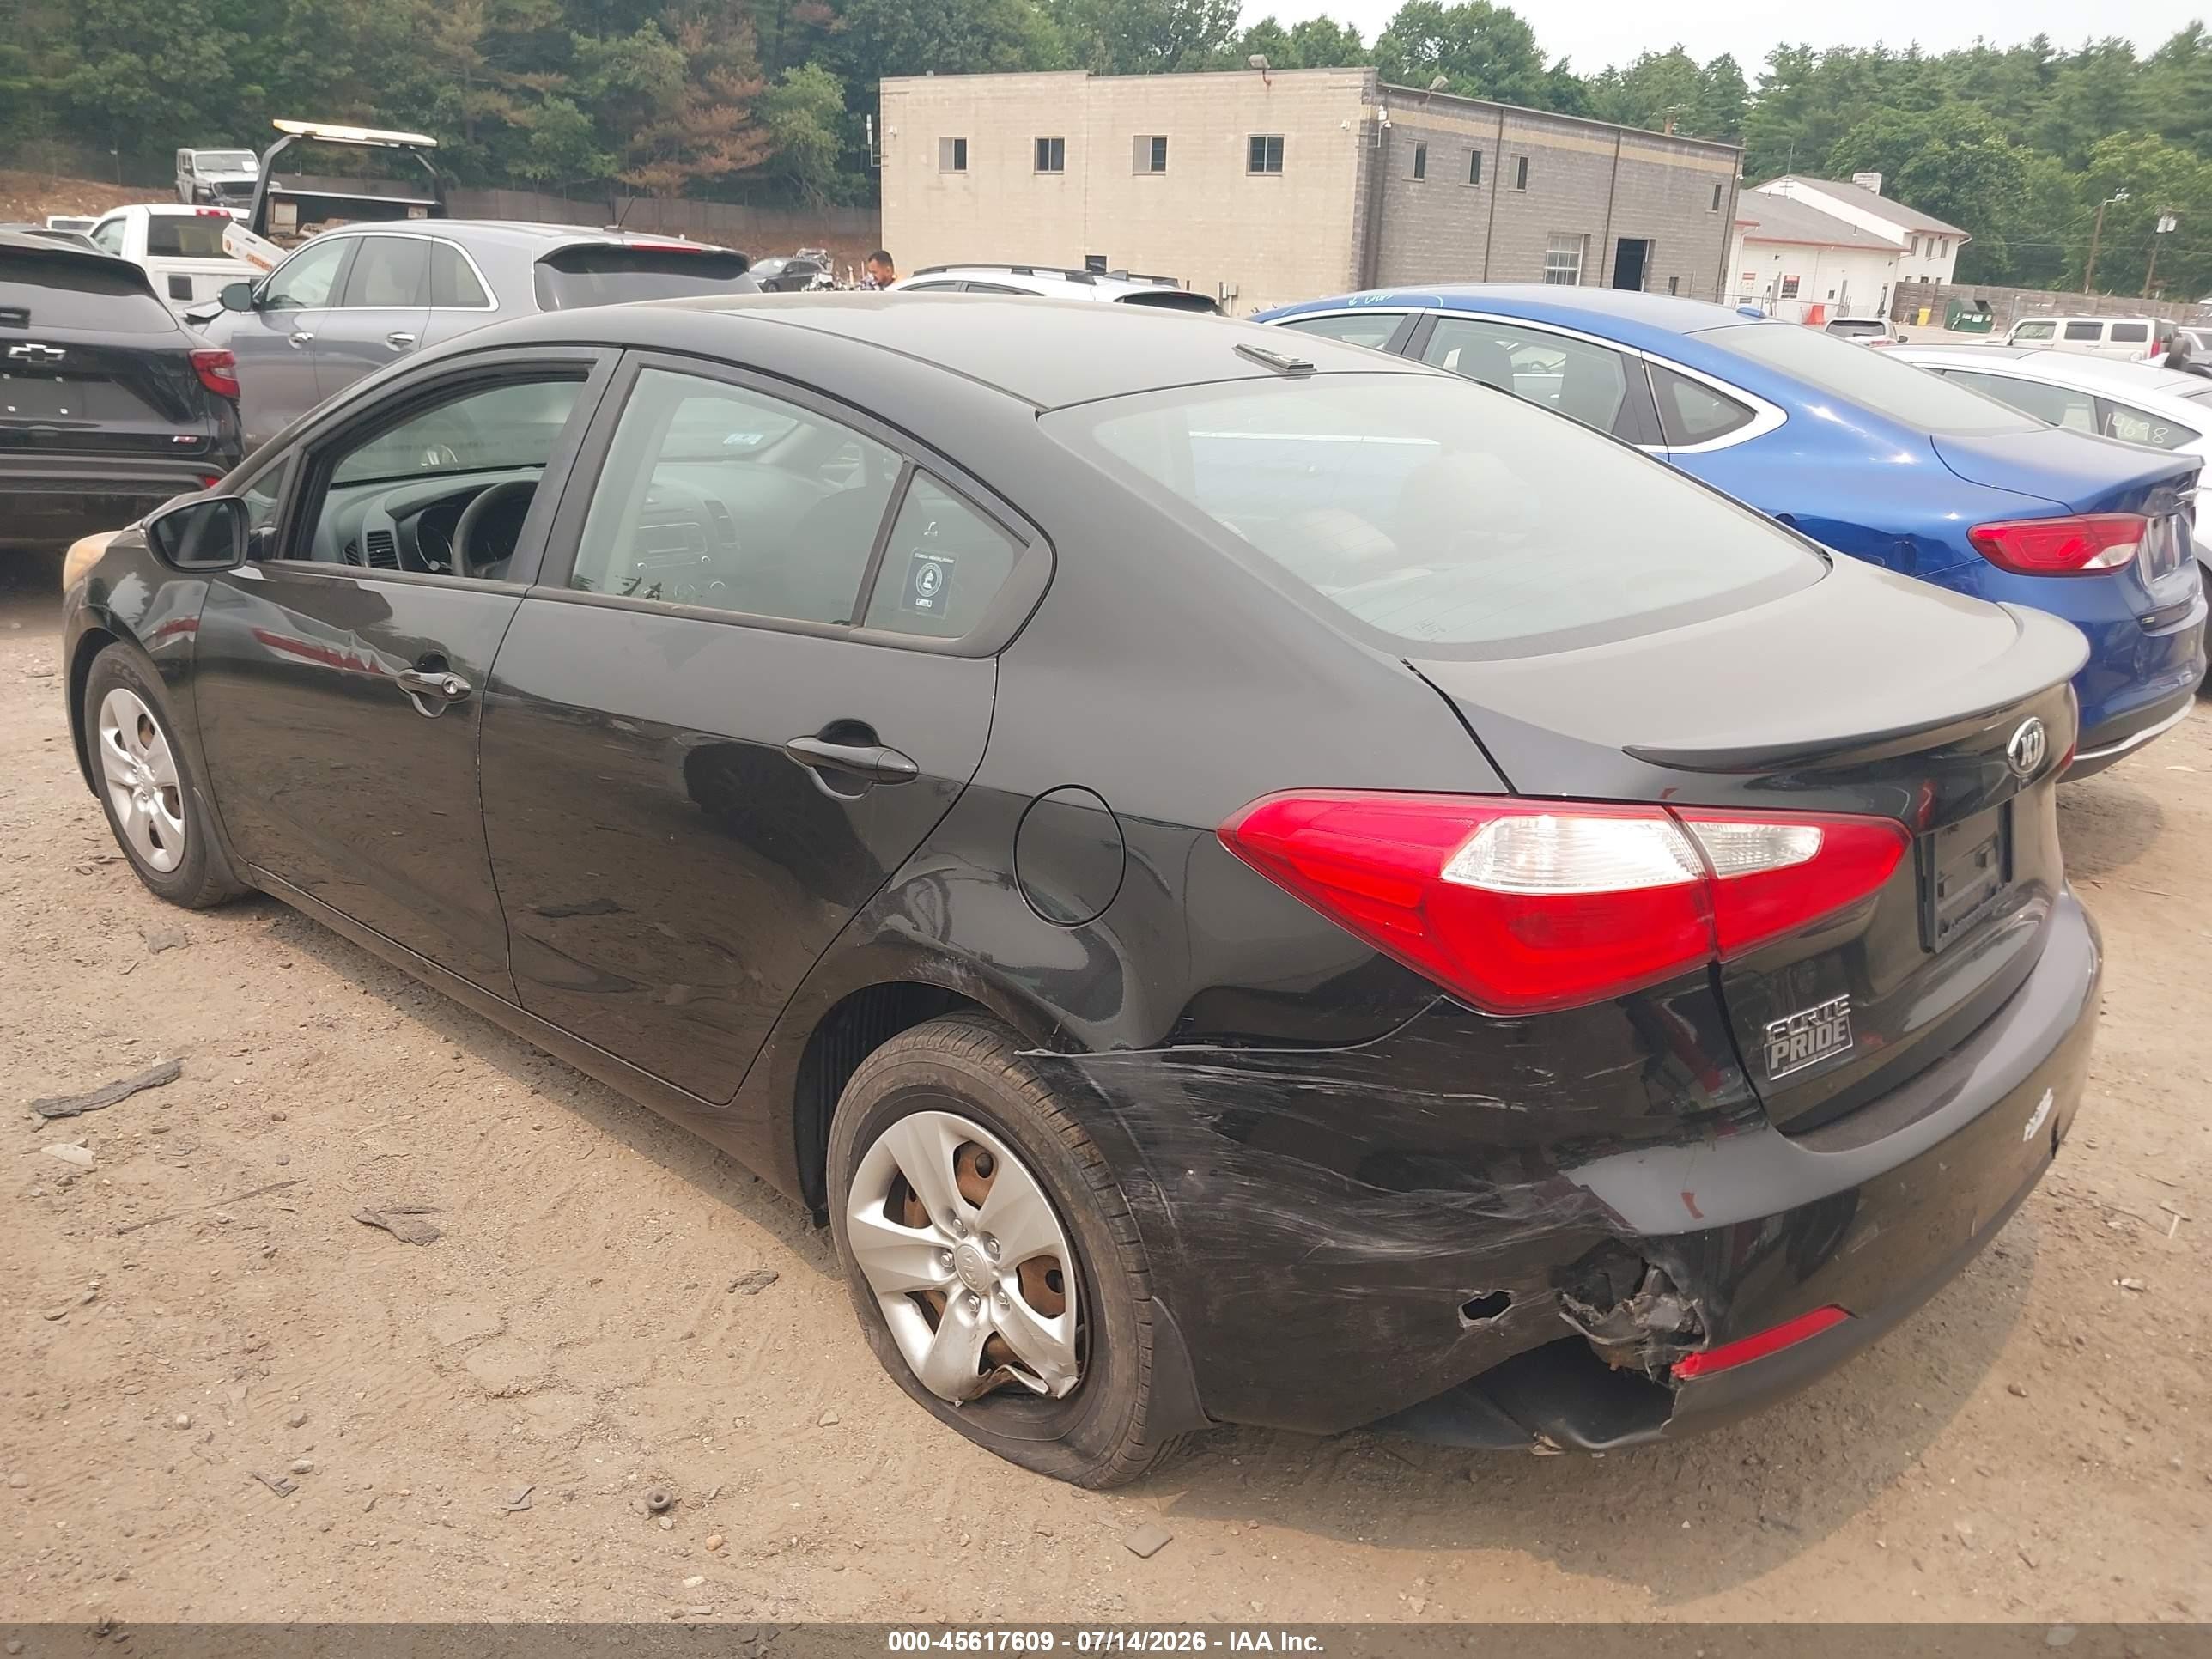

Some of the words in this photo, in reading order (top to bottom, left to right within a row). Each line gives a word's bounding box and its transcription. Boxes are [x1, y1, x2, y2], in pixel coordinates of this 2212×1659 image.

[2104, 413, 2169, 444] 14698
[1766, 994, 1851, 1044] FORTE
[1771, 1016, 1846, 1070] PRIDE
